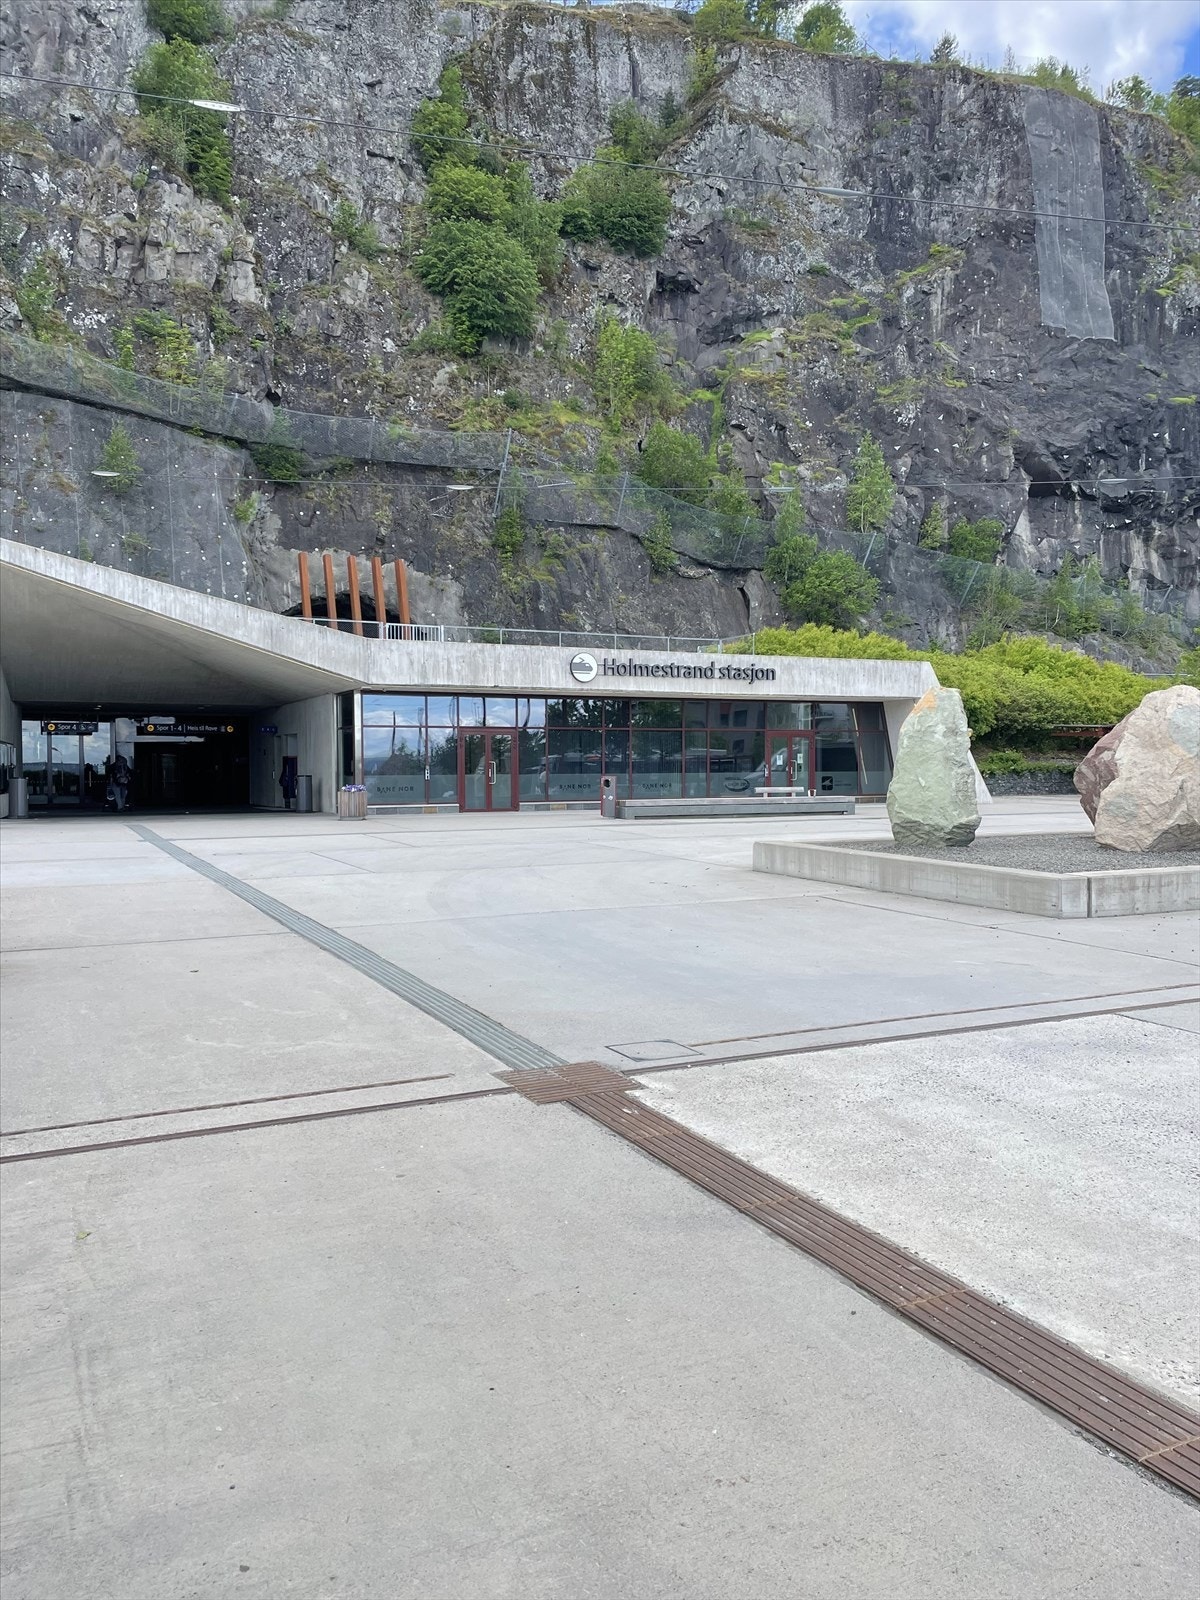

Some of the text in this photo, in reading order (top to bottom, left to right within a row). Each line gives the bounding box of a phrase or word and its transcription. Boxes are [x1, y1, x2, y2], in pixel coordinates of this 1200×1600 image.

[603, 658, 777, 684] Holmestrand stasjon
[57, 723, 70, 731] Spor
